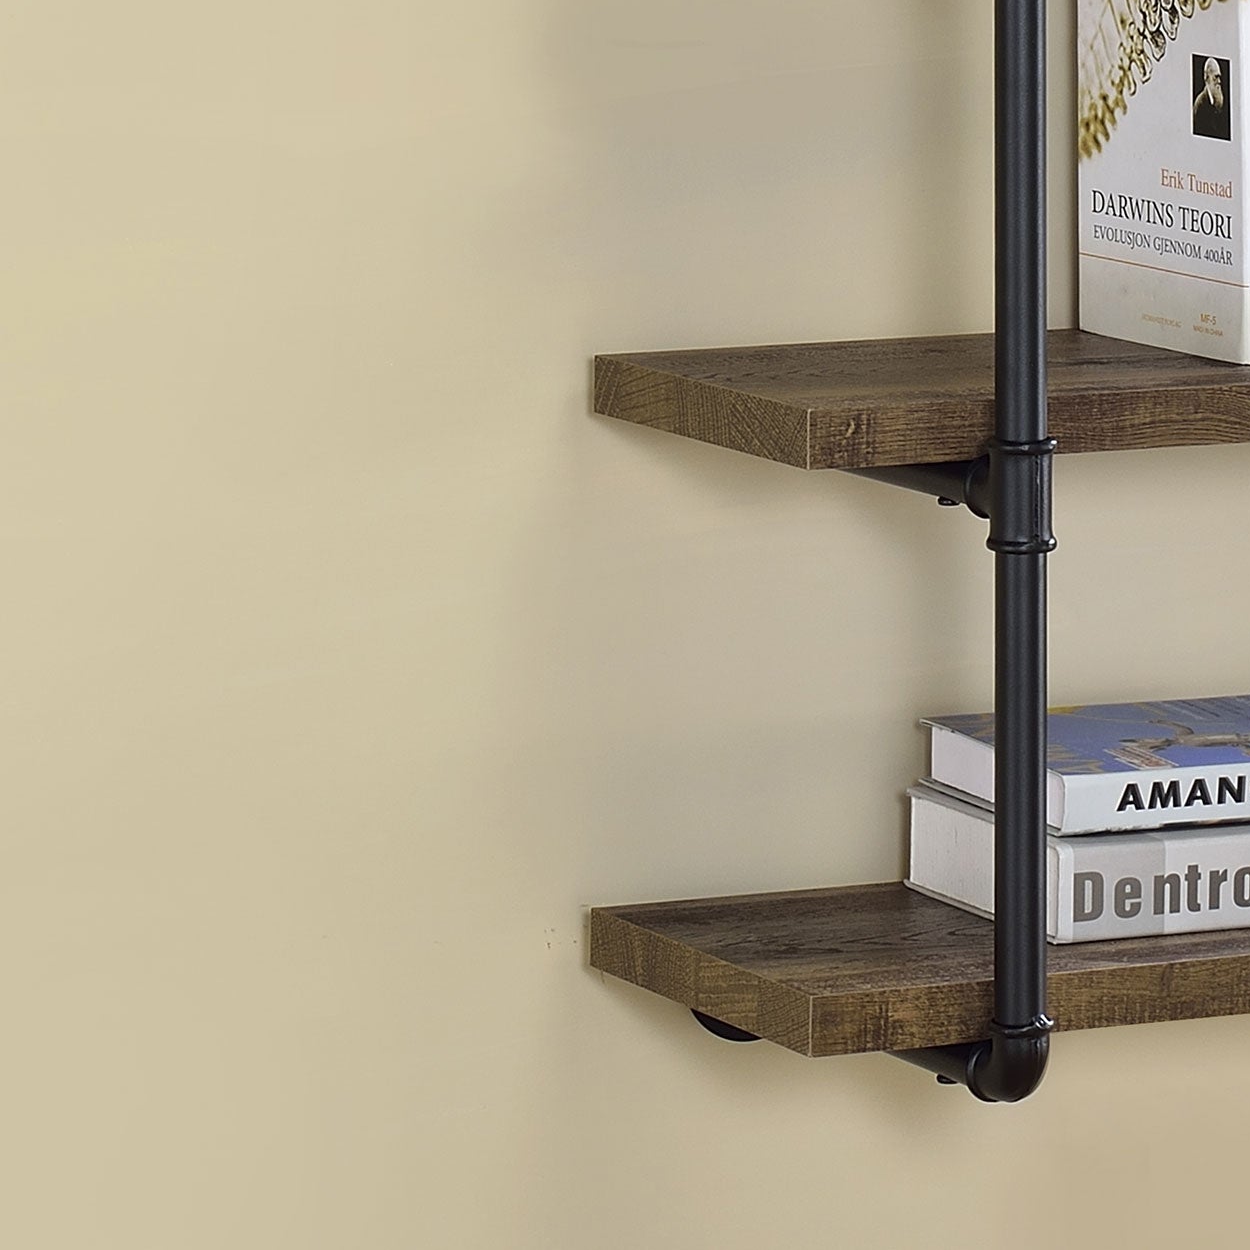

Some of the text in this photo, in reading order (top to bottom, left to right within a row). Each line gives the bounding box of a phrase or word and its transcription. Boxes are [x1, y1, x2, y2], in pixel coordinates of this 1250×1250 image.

[1160, 168, 1233, 199] Erik Tunstad
[1091, 190, 1233, 240] DARWINS TEORI
[1093, 224, 1234, 266] EVOLUSJON GJENNOM 400ÅR
